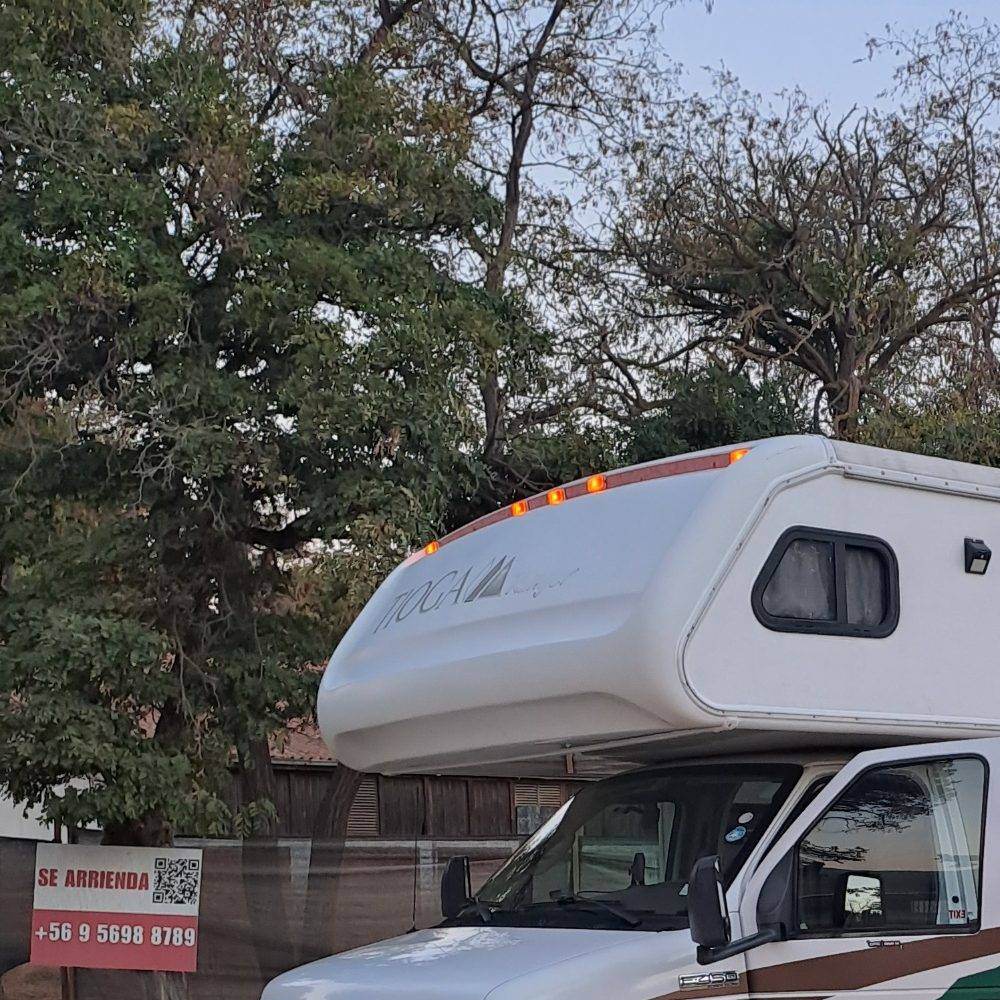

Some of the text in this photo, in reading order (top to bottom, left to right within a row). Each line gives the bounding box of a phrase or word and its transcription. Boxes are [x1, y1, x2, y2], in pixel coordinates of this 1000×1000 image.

[38, 868, 150, 891] SE ARRIENDA
[35, 922, 196, 947] +56 9 5698 8789
